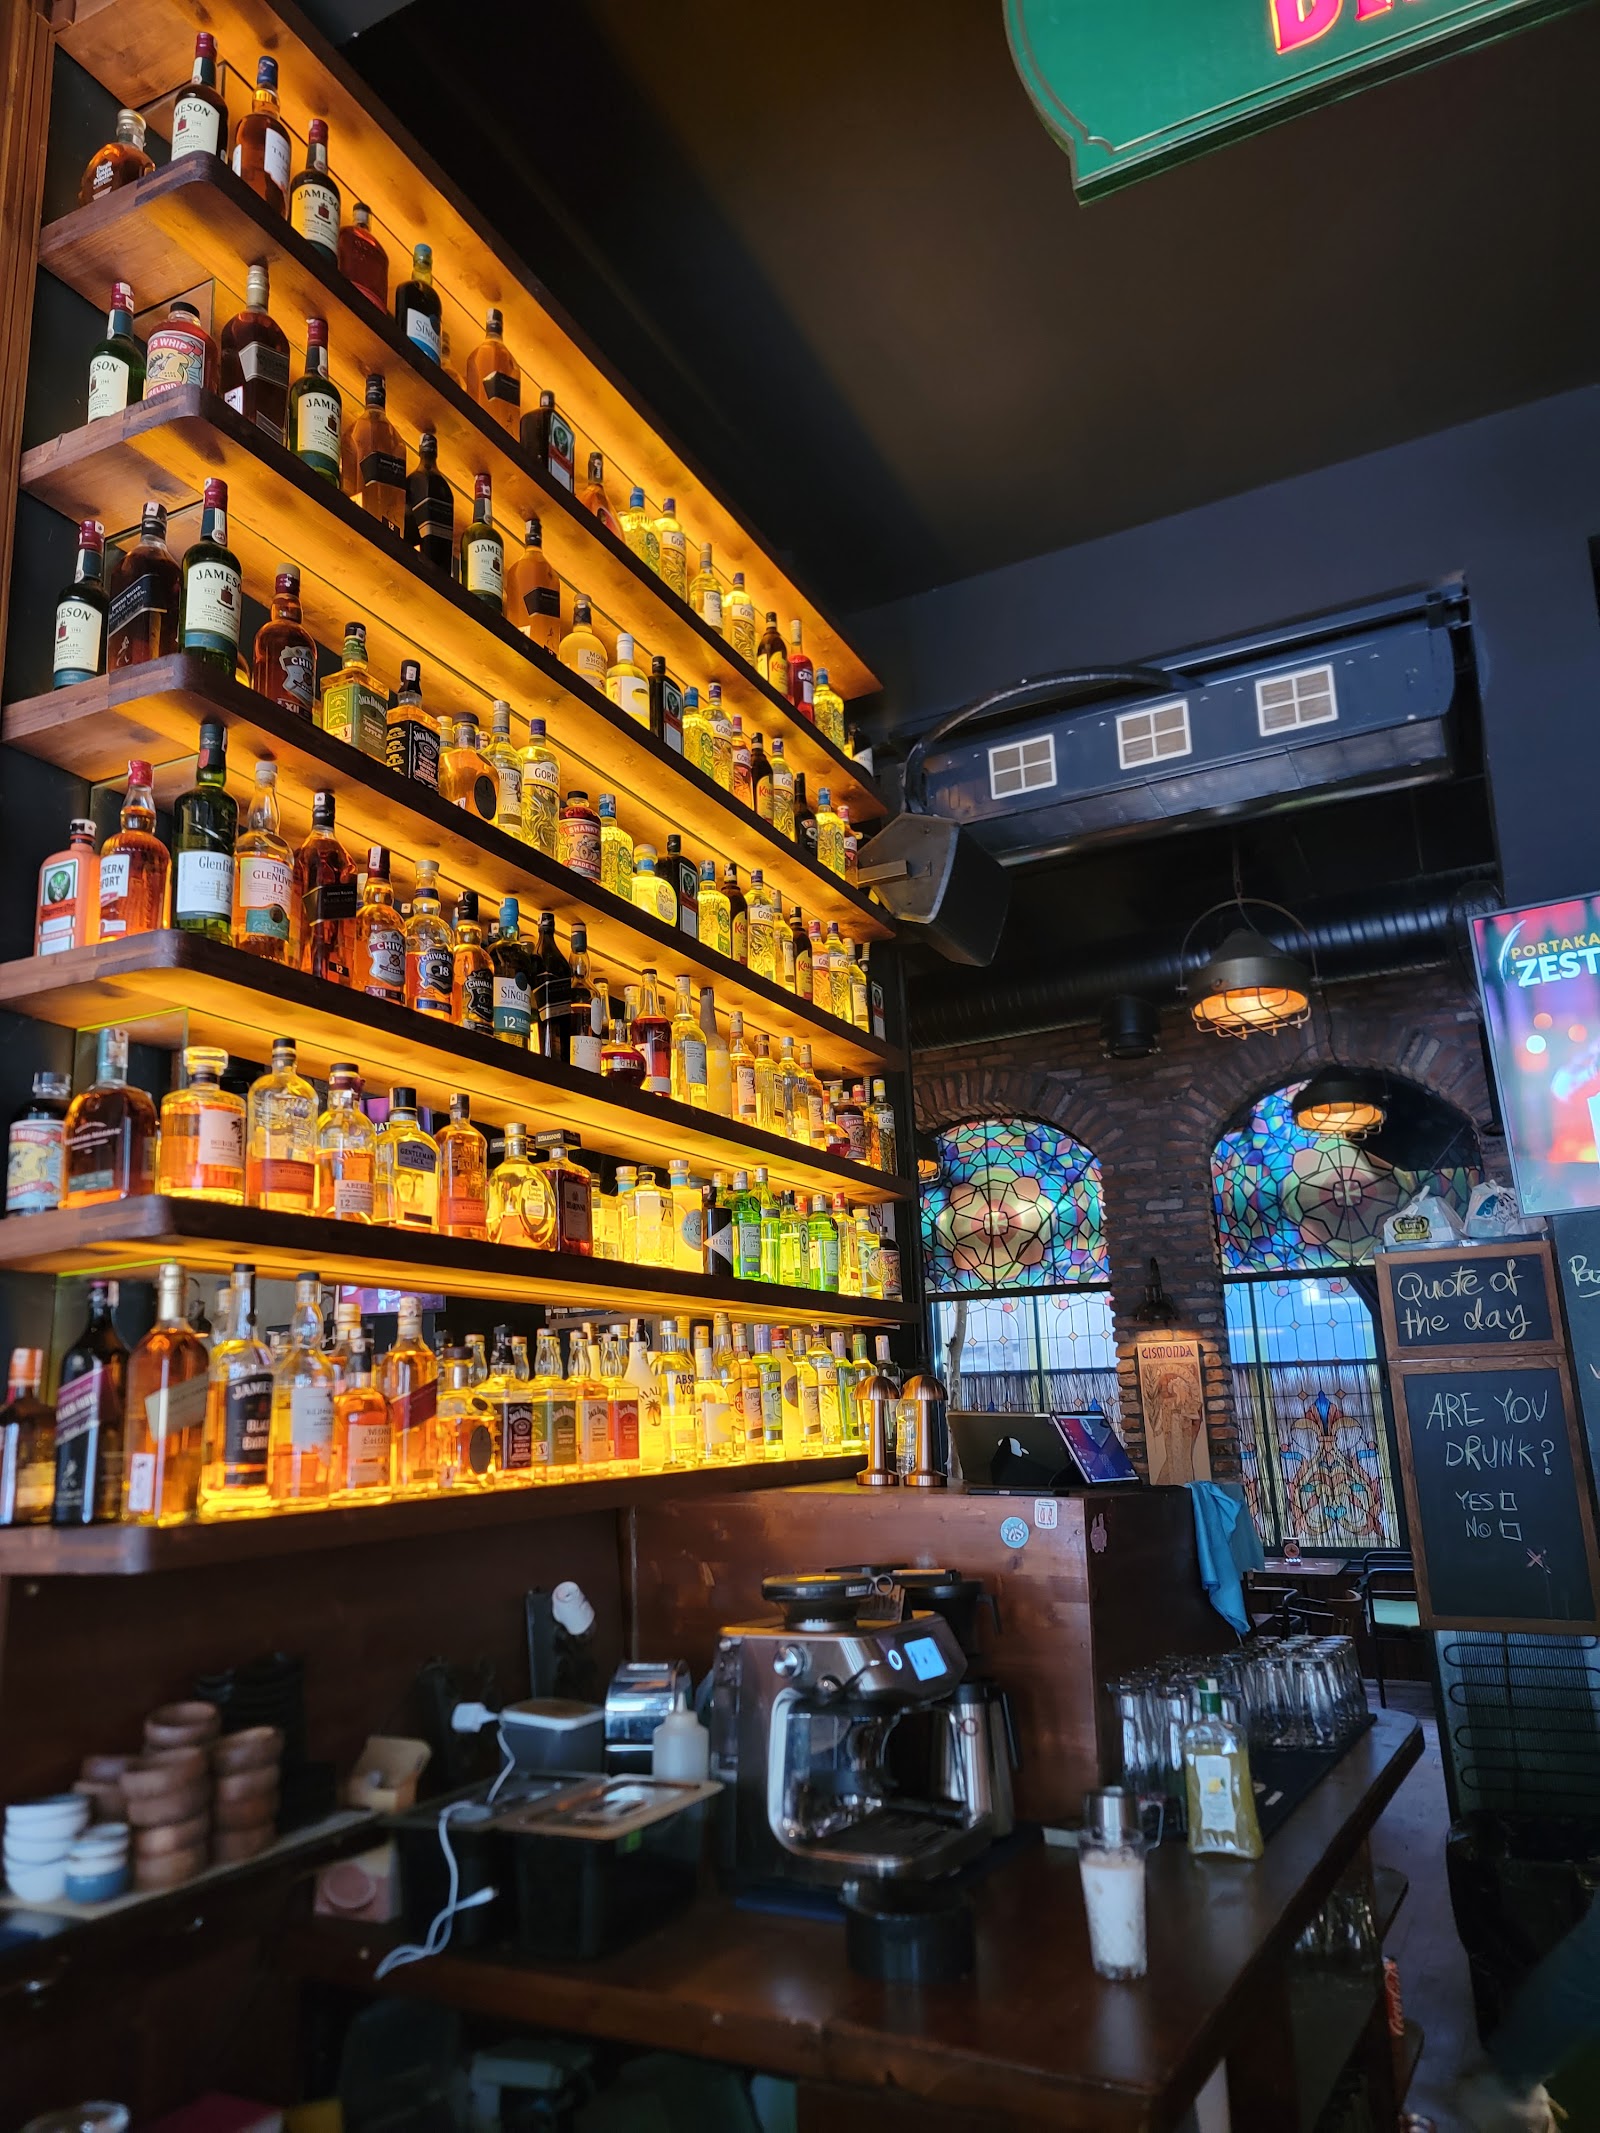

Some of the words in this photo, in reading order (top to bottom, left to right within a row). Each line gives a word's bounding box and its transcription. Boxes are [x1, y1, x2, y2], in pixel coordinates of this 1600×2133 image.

[160, 337, 188, 350] WHIP
[272, 865, 286, 876] THE
[272, 883, 284, 895] 12
[336, 964, 344, 974] 12
[438, 965, 450, 976] 18
[504, 1016, 516, 1029] 12
[1398, 1266, 1484, 1307] Quote
[1490, 1259, 1524, 1296] of
[1401, 1307, 1450, 1340] the
[1464, 1298, 1532, 1340] day
[1142, 1345, 1194, 1359] GISMONDA
[1426, 1392, 1485, 1431] ARE
[1494, 1388, 1548, 1424] YOU
[1445, 1434, 1555, 1476] DRUNK?
[1455, 1490, 1494, 1511] YES
